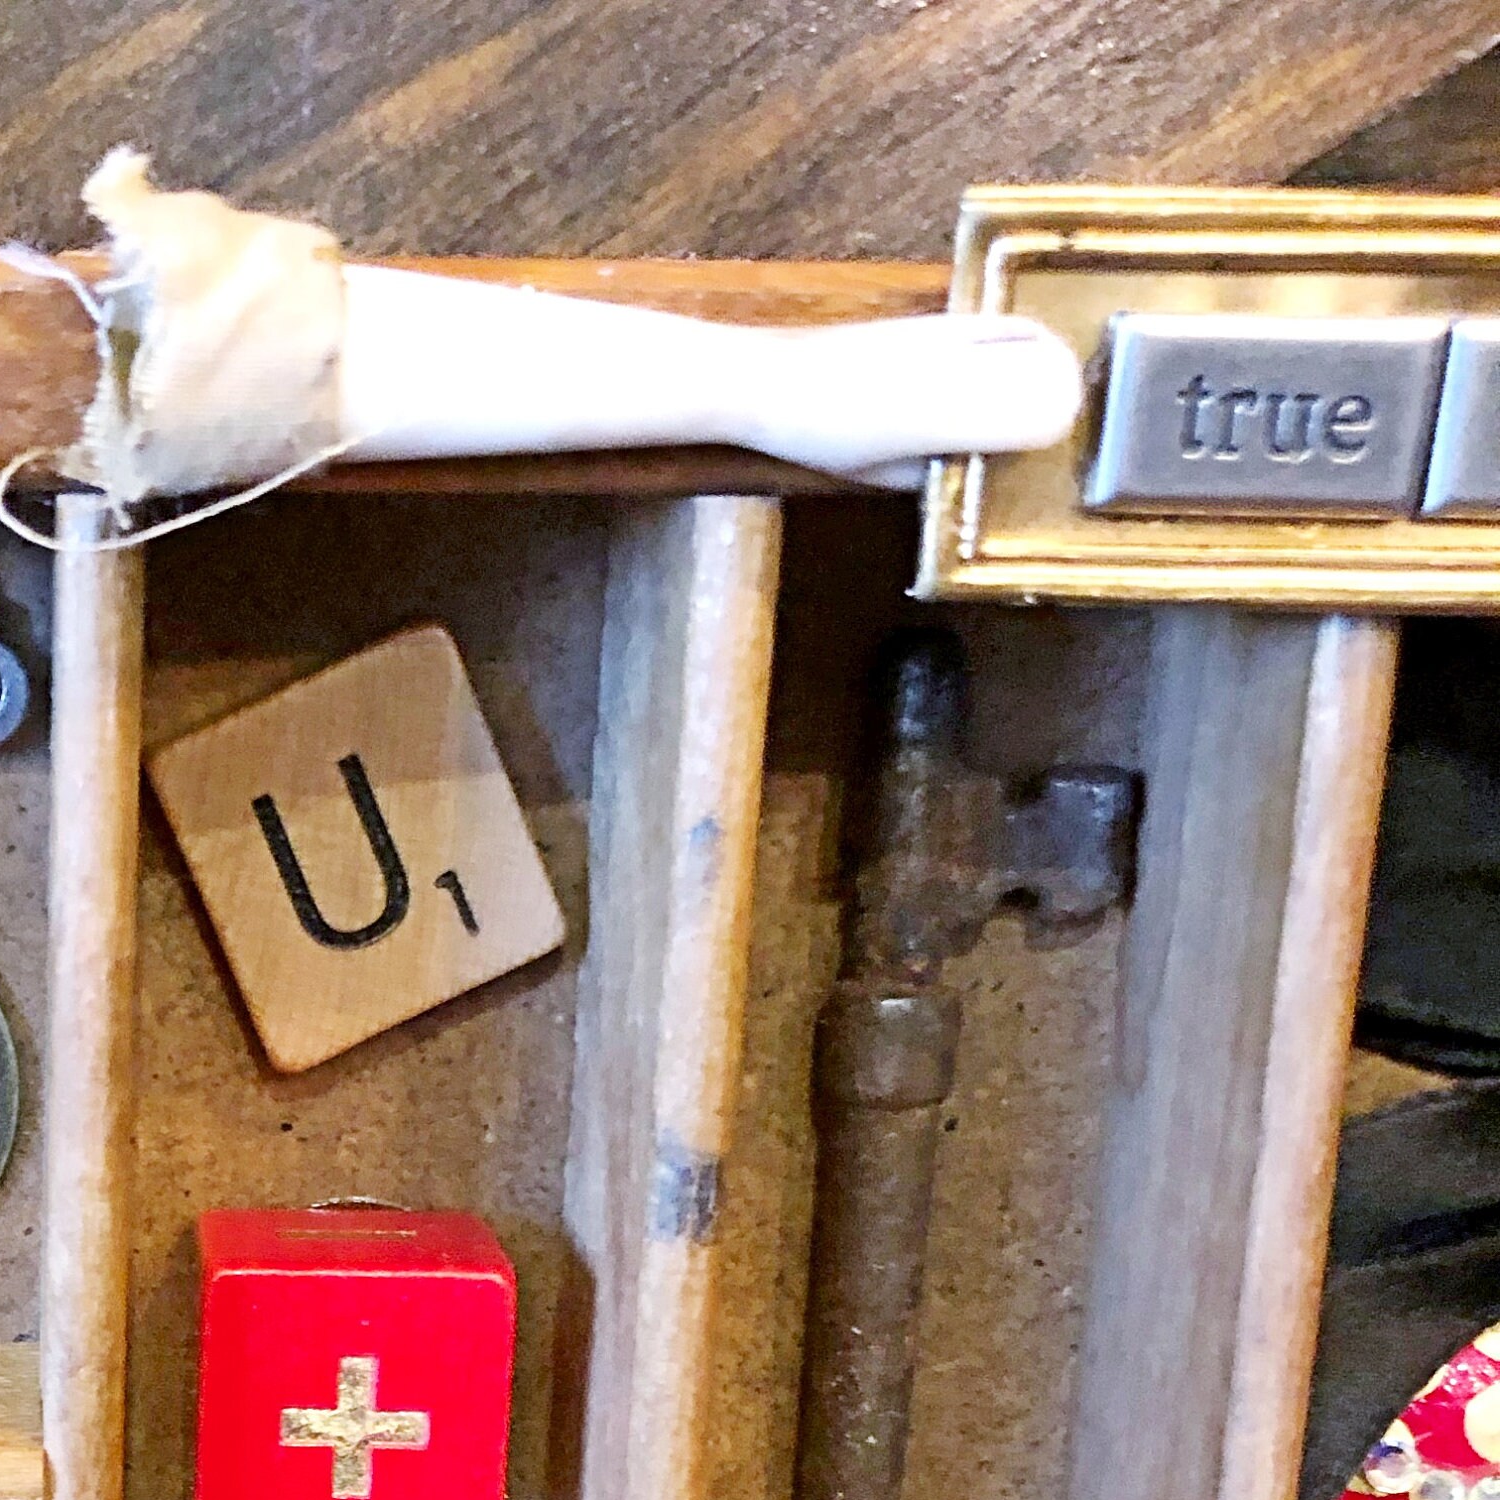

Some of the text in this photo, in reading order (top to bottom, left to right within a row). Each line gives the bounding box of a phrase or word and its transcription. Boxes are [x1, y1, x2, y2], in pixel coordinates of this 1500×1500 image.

[1176, 374, 1376, 463] true
[250, 753, 480, 951] U 1
